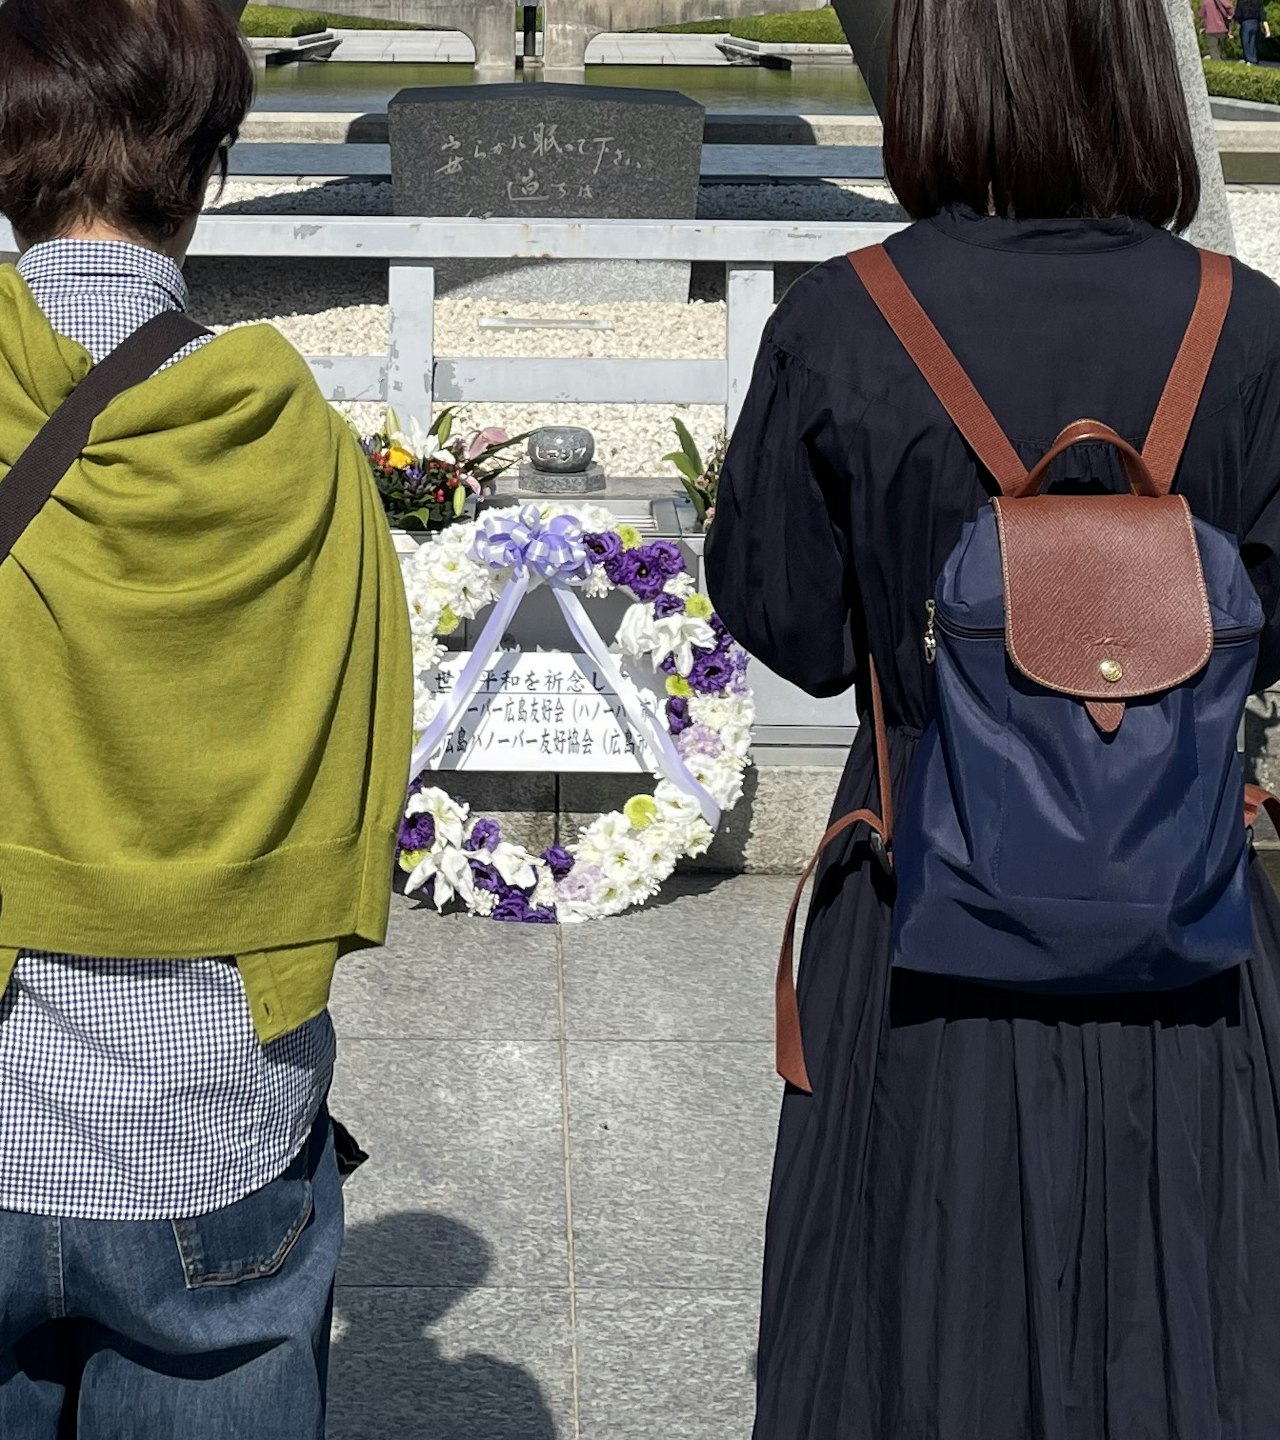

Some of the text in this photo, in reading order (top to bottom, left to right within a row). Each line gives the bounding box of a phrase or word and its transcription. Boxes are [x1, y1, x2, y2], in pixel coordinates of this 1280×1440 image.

[434, 121, 642, 175] 安らかに眠って下さい
